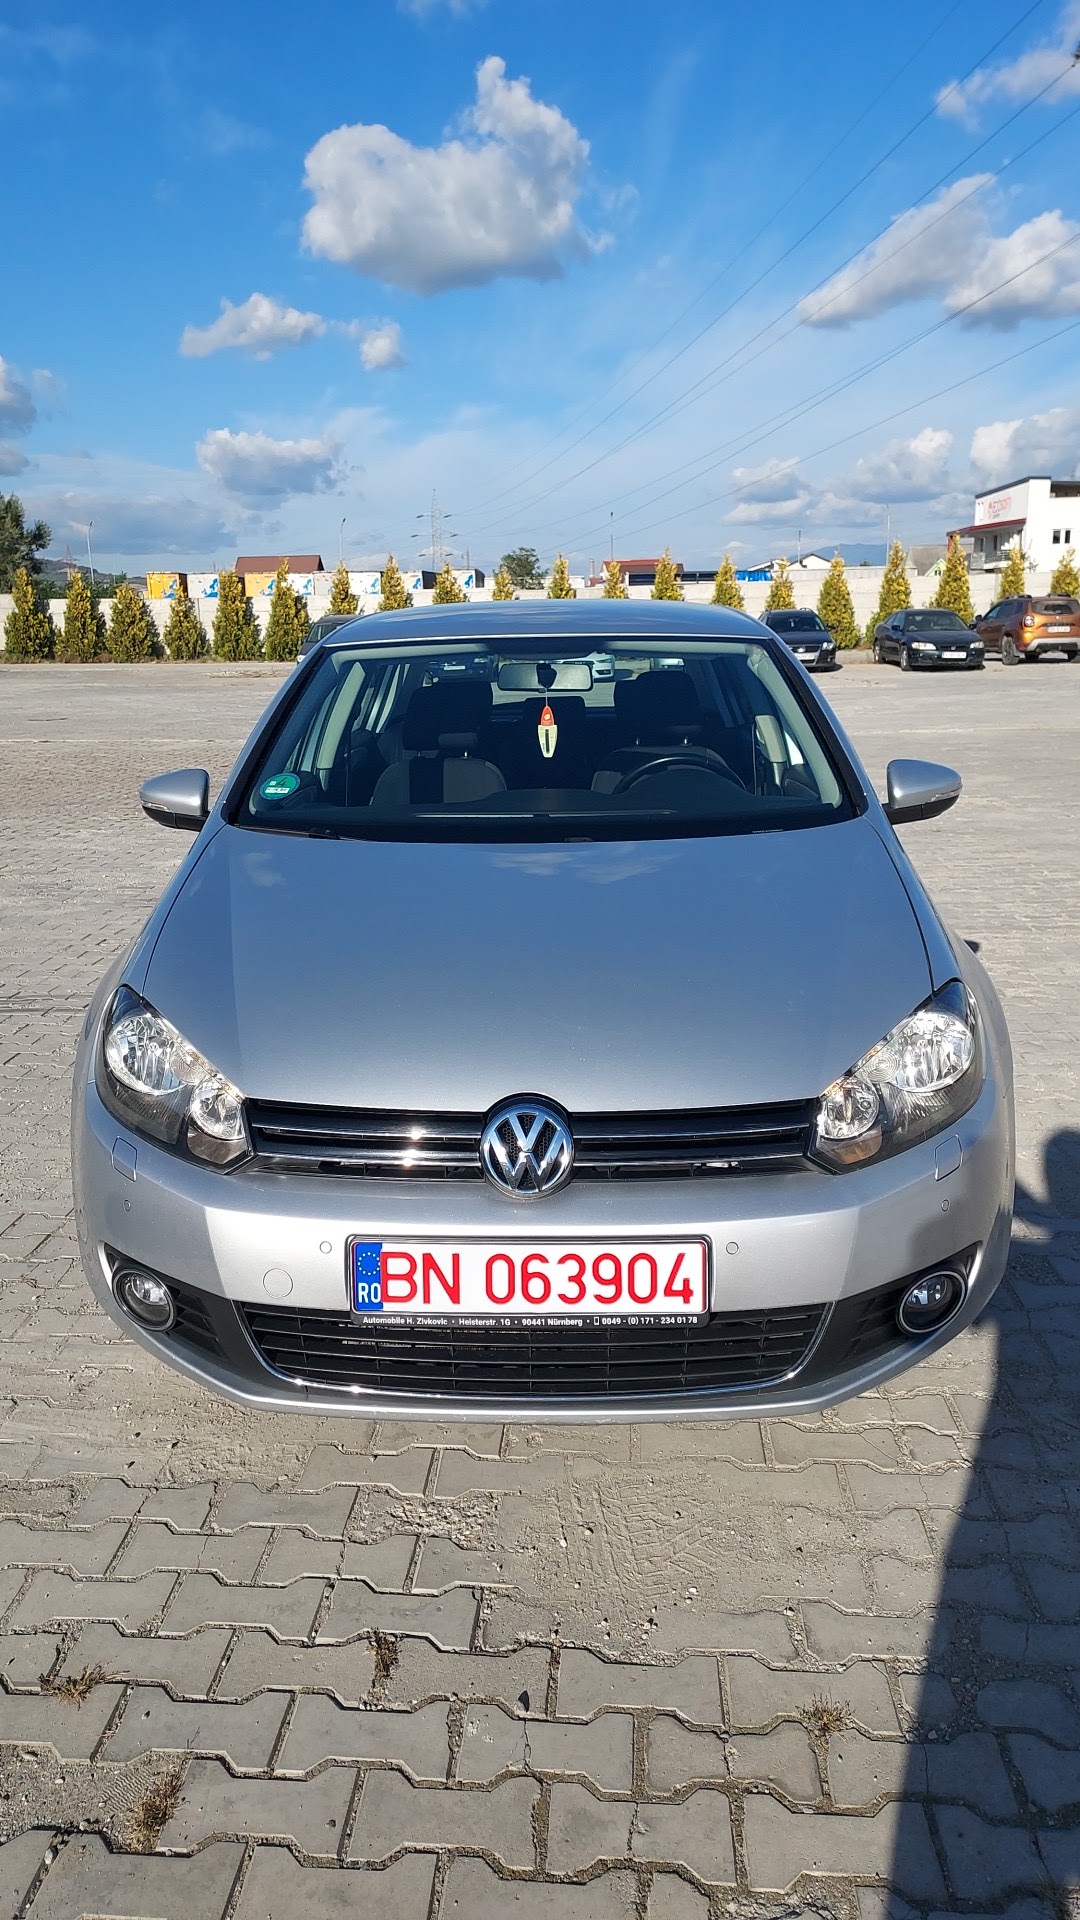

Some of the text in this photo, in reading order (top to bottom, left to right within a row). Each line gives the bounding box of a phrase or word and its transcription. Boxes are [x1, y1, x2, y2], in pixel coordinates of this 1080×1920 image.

[380, 1251, 694, 1305] BN 063904
[358, 1282, 382, 1304] RO
[362, 1316, 405, 1325] Automobile
[406, 1317, 415, 1325] H.
[458, 1318, 499, 1326] Heisterstr.
[521, 1318, 545, 1326] 90441
[547, 1317, 583, 1327] Nürnberg
[601, 1317, 621, 1325] 0049
[627, 1316, 639, 1326] (0)
[640, 1317, 654, 1325] 171
[660, 1316, 675, 1325] 234
